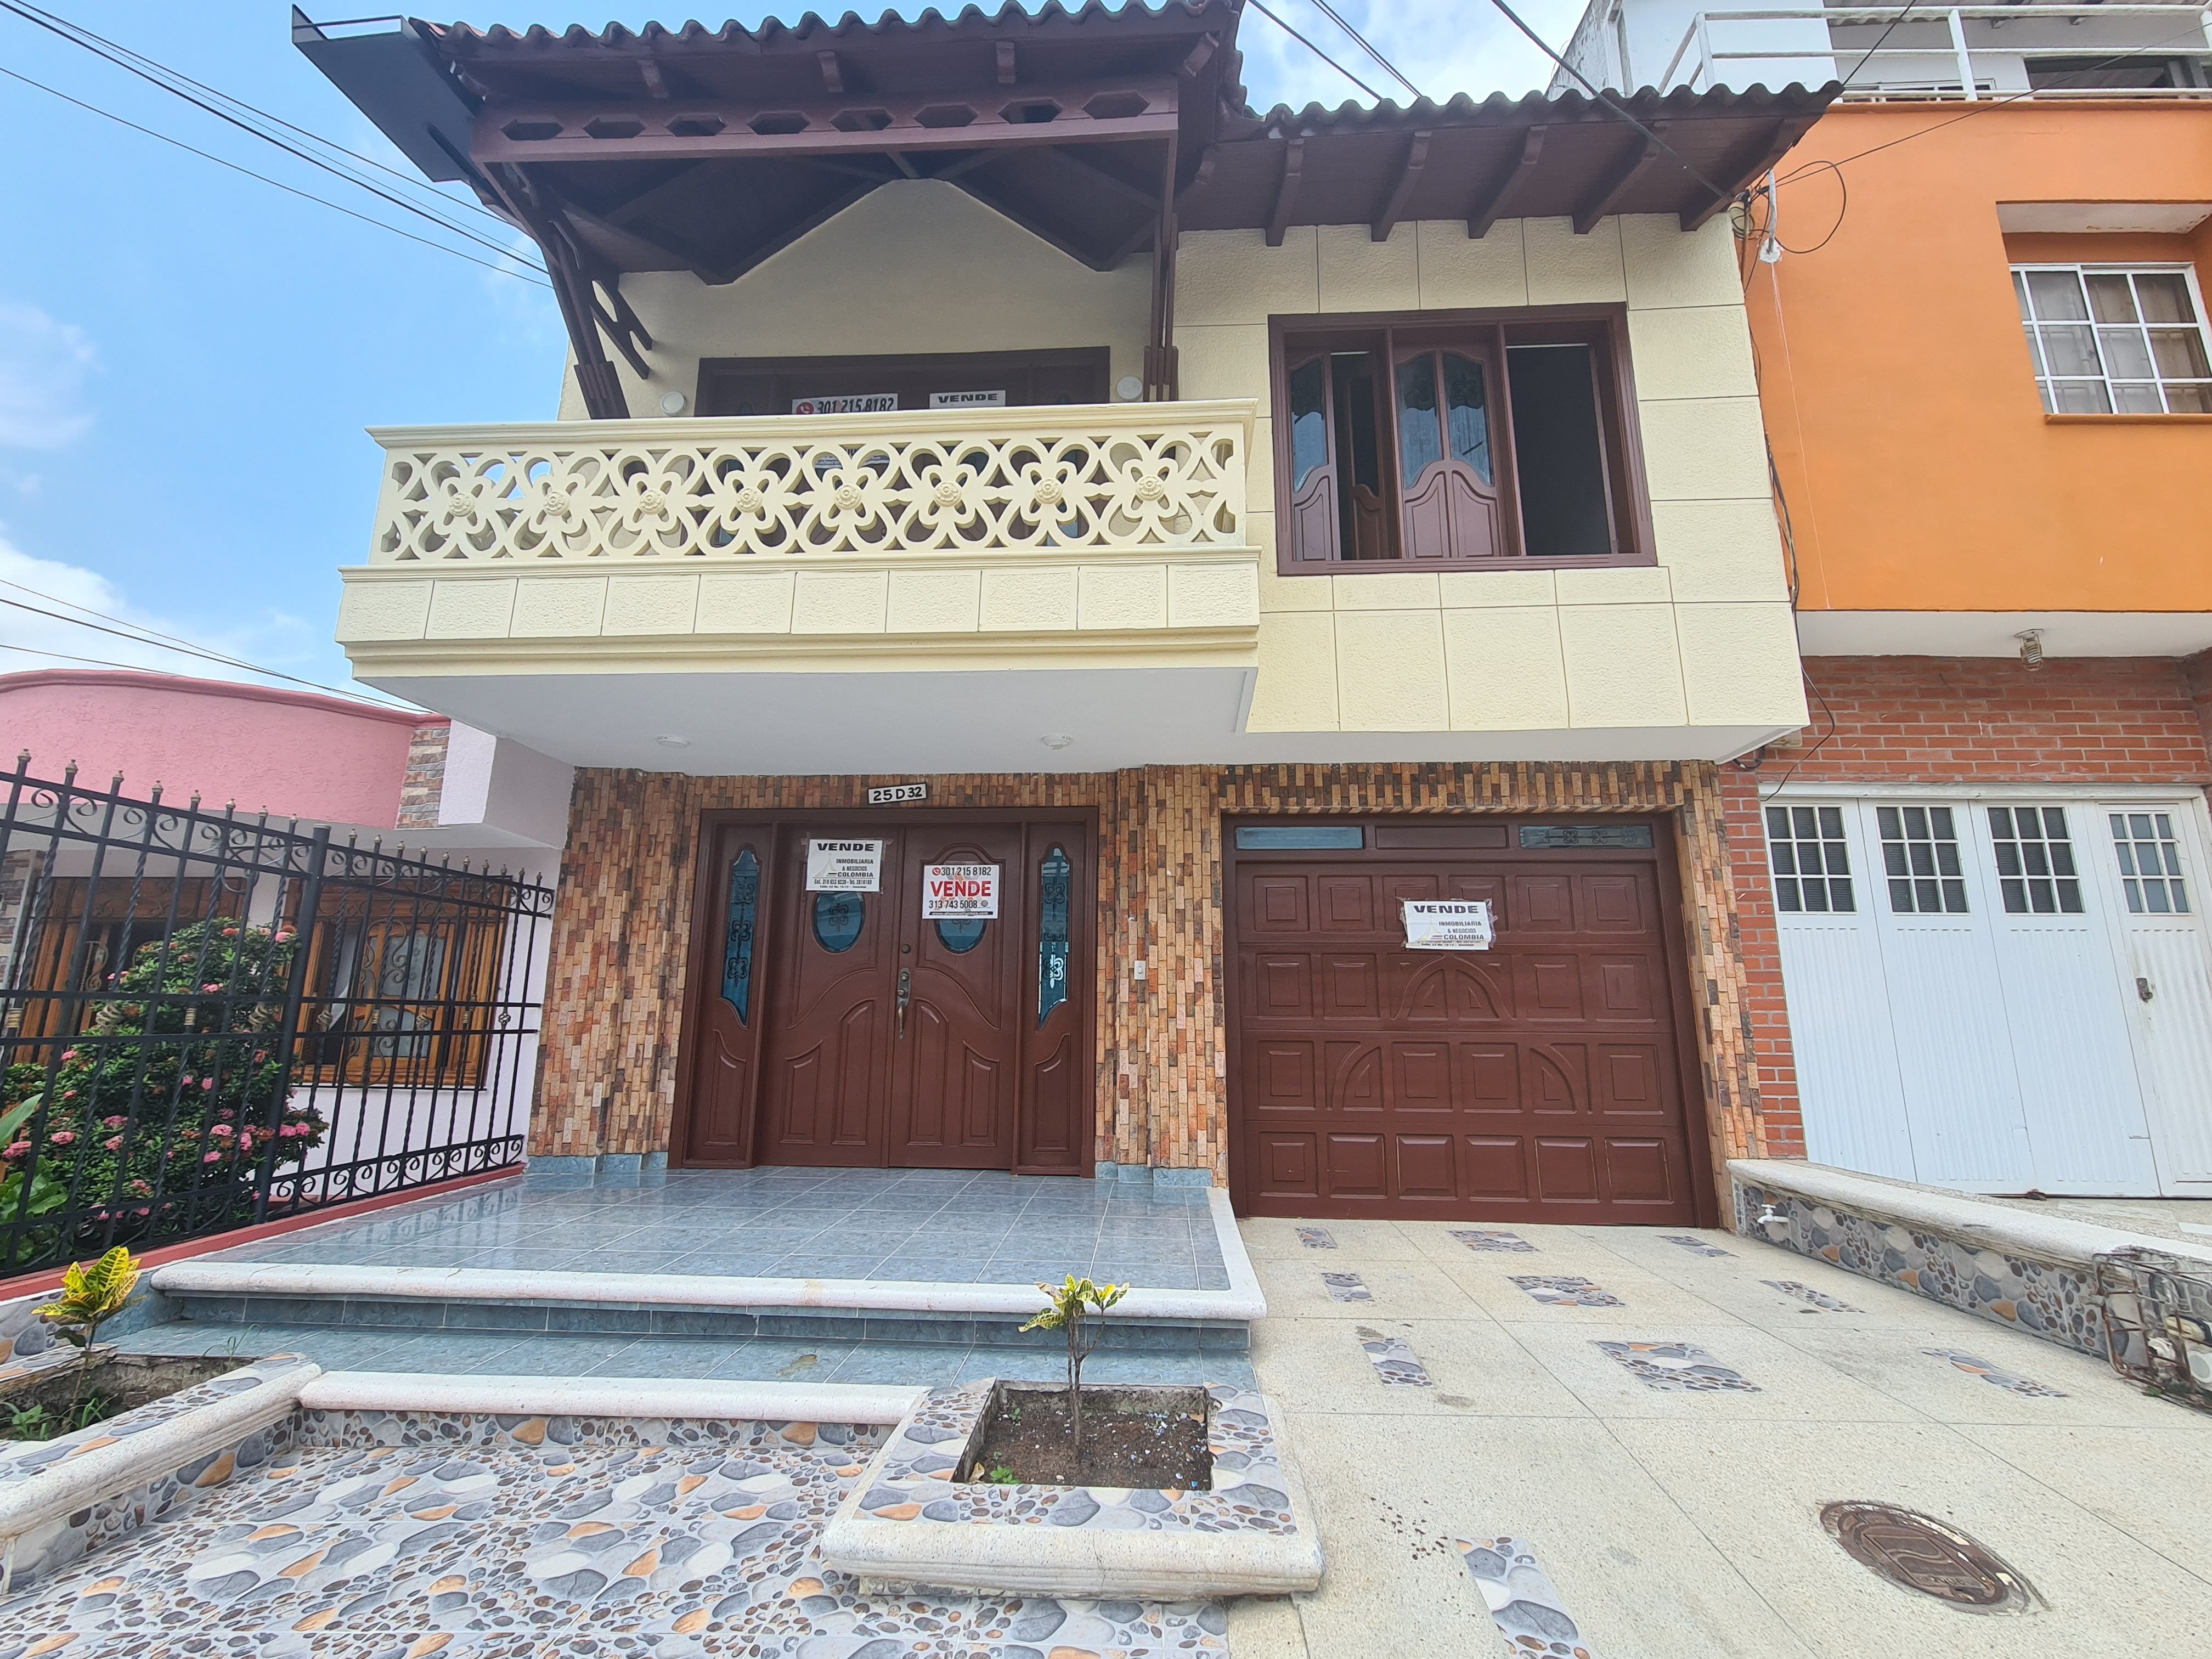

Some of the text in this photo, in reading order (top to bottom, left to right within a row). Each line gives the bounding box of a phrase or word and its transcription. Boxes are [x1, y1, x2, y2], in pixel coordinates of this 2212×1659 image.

[938, 393, 997, 403] VENDE
[818, 397, 895, 413] 301 215 8182
[873, 786, 923, 801] 25 D 32
[817, 843, 874, 851] VENDE
[941, 867, 991, 876] 301 215 8182
[930, 881, 991, 896] VENDE
[929, 900, 978, 909] 313 743 5008
[1413, 905, 1479, 913] VENDE
